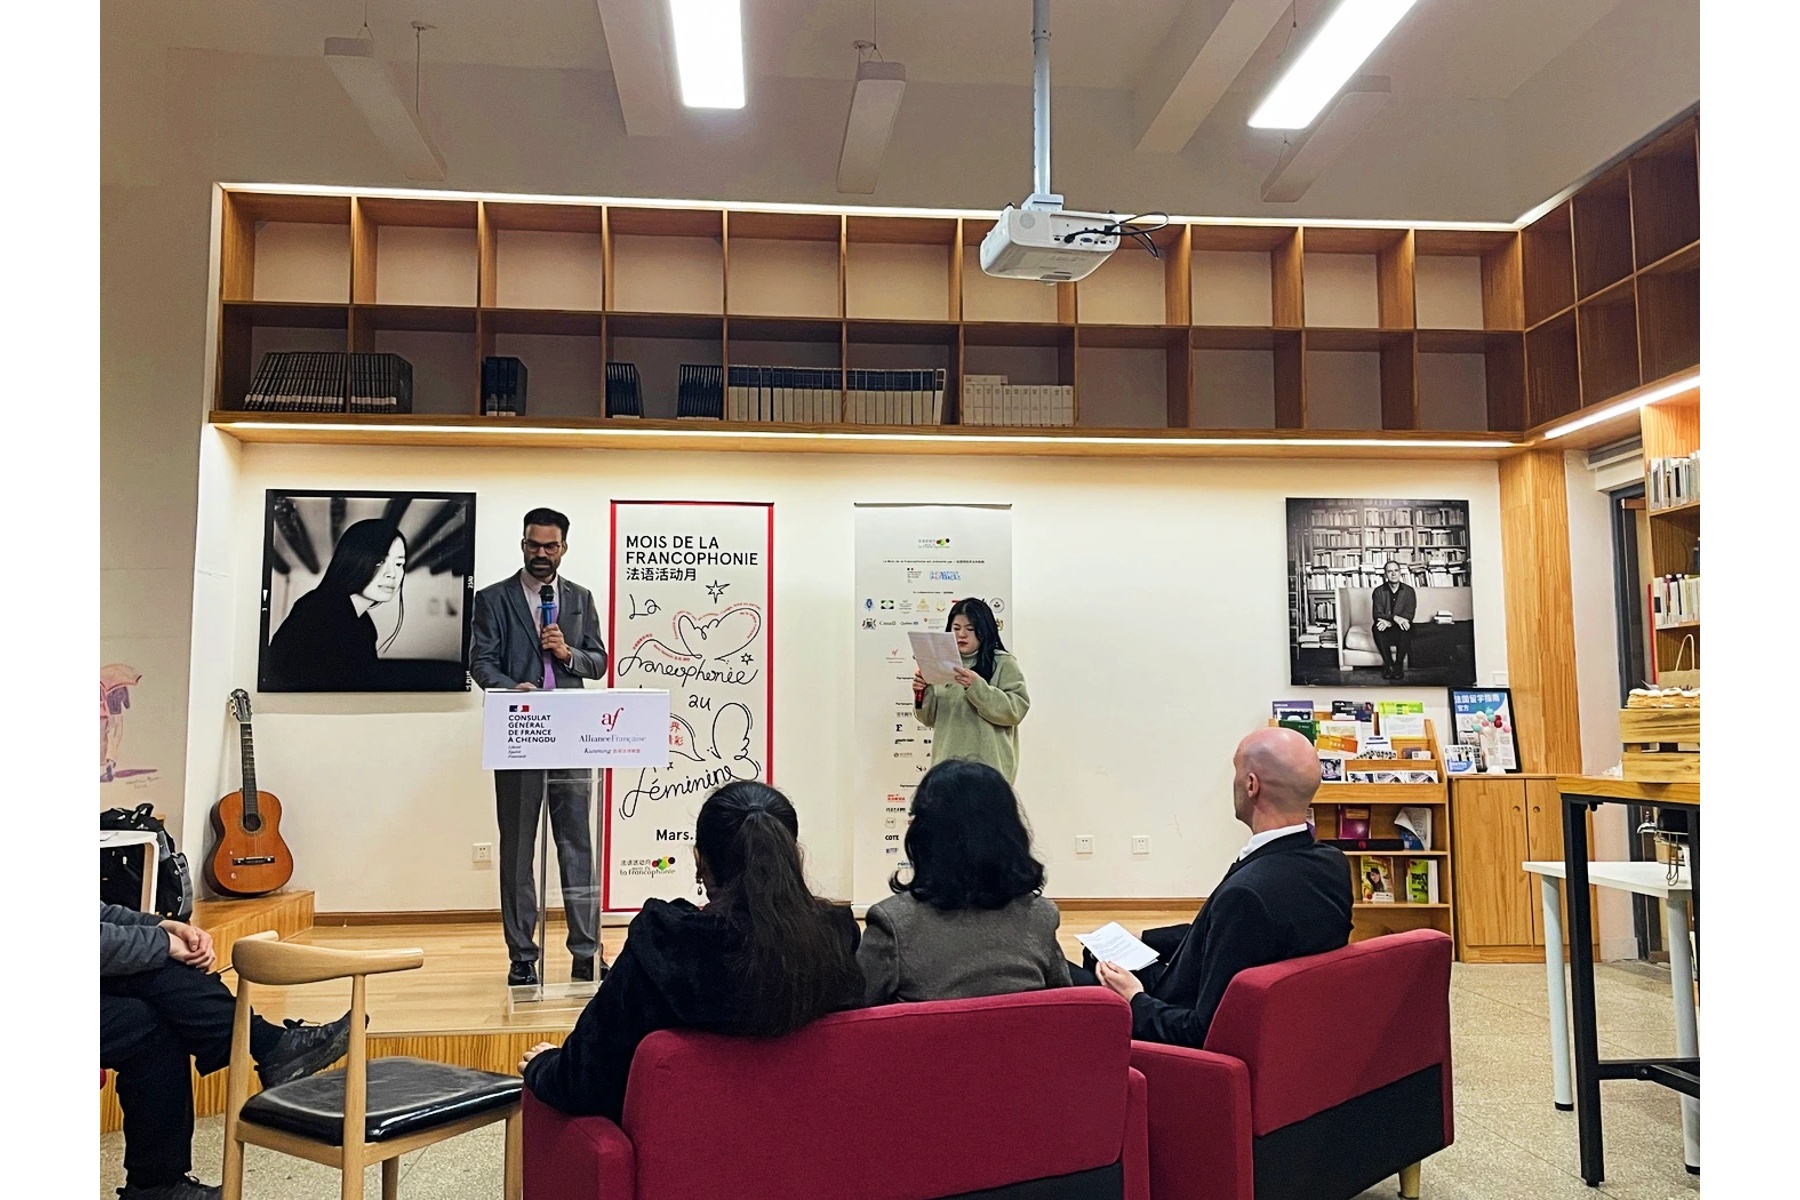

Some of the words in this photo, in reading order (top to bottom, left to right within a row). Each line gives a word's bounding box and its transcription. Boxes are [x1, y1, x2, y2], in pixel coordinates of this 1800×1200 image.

[626, 536, 667, 549] MOIS
[673, 536, 694, 549] DE
[700, 537, 719, 549] LA
[626, 552, 758, 566] FRANCOPHONIE
[626, 568, 697, 581] 法语活动月
[629, 594, 662, 620] La
[688, 694, 711, 711] au
[601, 707, 625, 732] af
